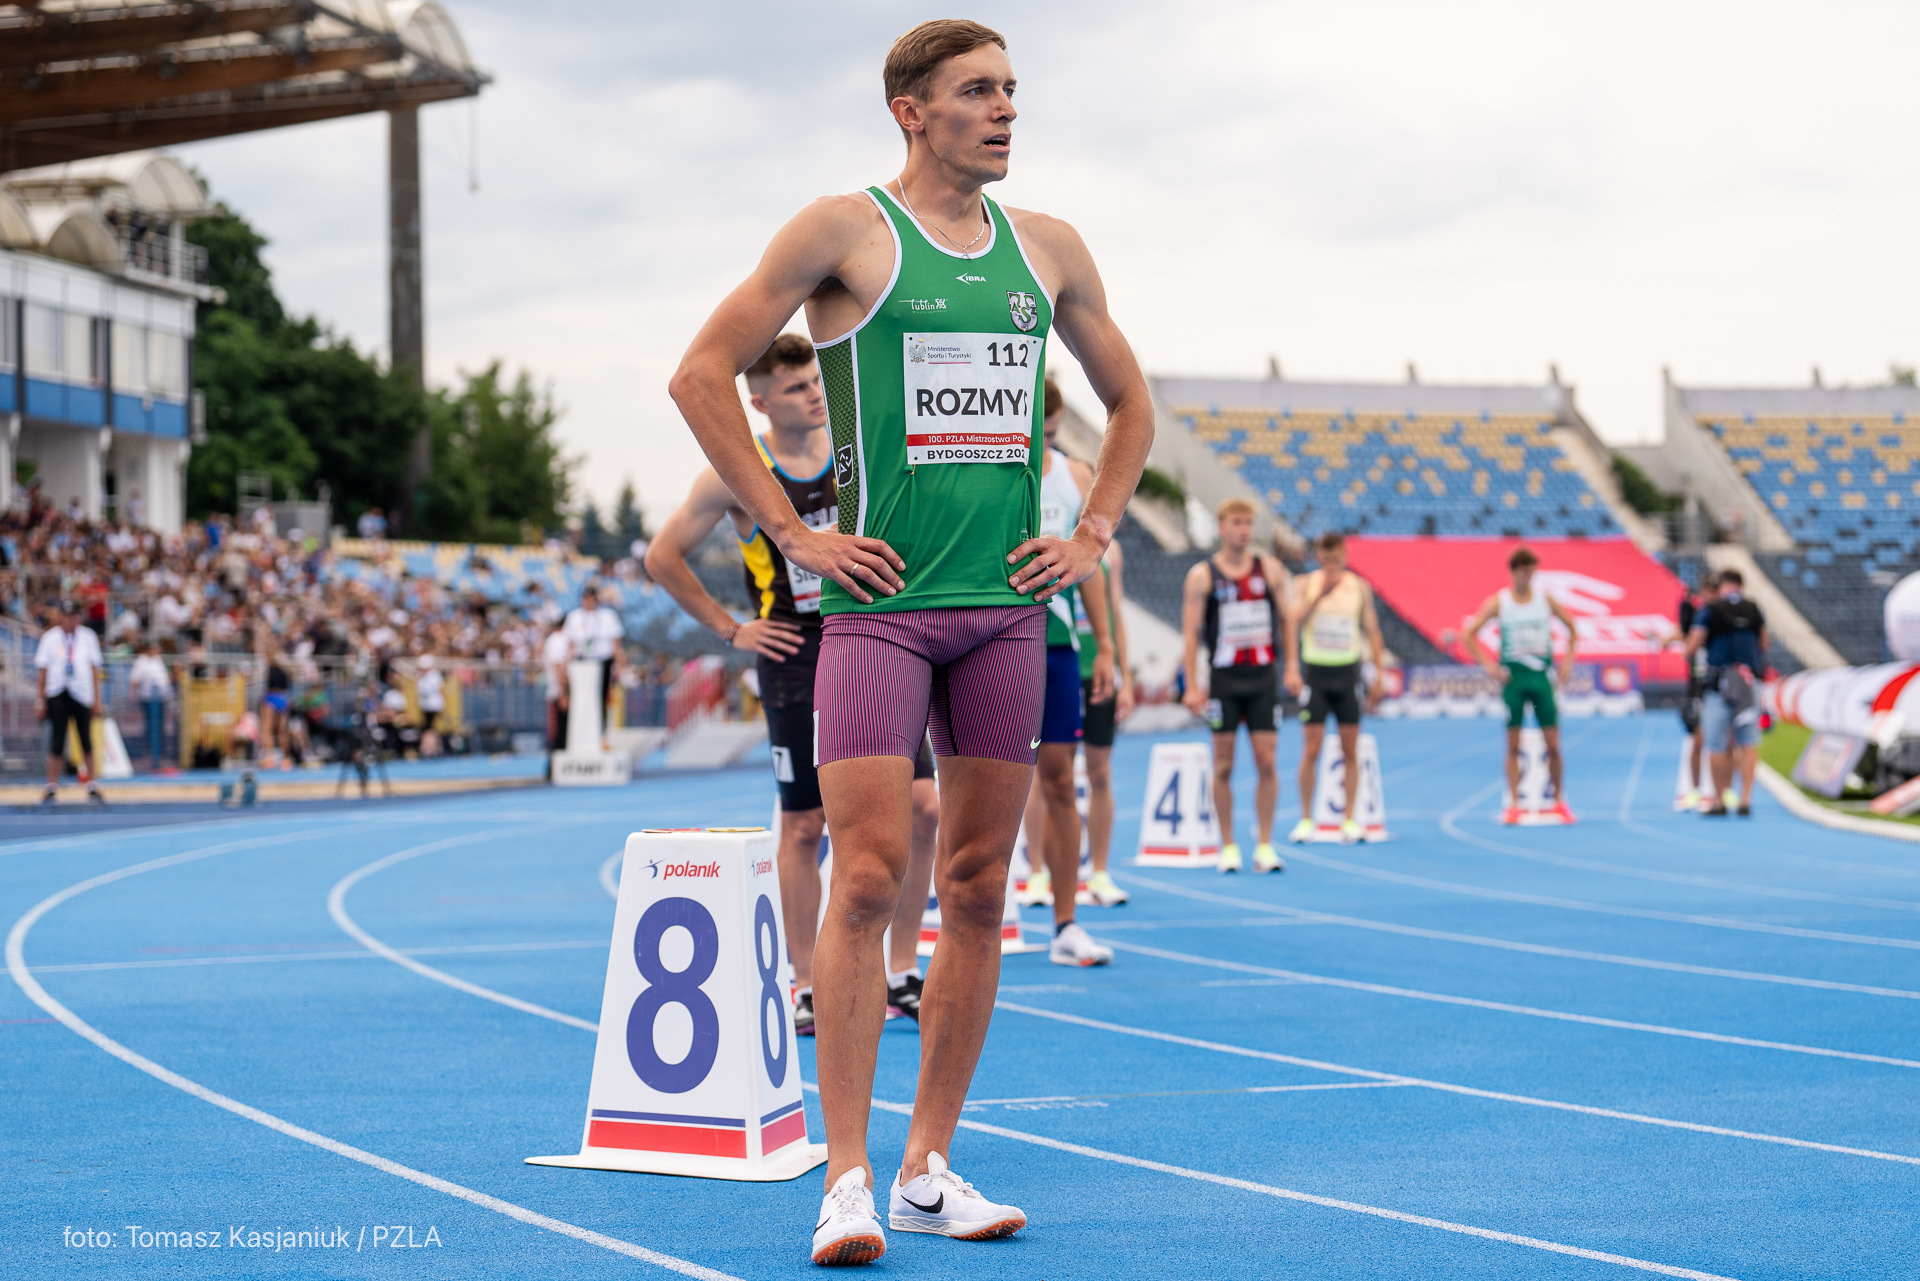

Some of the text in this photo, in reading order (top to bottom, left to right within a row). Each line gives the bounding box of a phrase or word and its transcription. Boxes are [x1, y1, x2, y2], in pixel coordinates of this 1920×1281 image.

[927, 352, 945, 360] Sportu
[928, 435, 945, 443] 100.
[966, 434, 1011, 443] Mistrzostwa
[927, 449, 1004, 460] BYDGOSZCZ
[1153, 767, 1184, 836] 4
[663, 860, 721, 881] polanik
[756, 856, 773, 879] polanik
[626, 896, 719, 1094] 8
[754, 894, 788, 1089] 8
